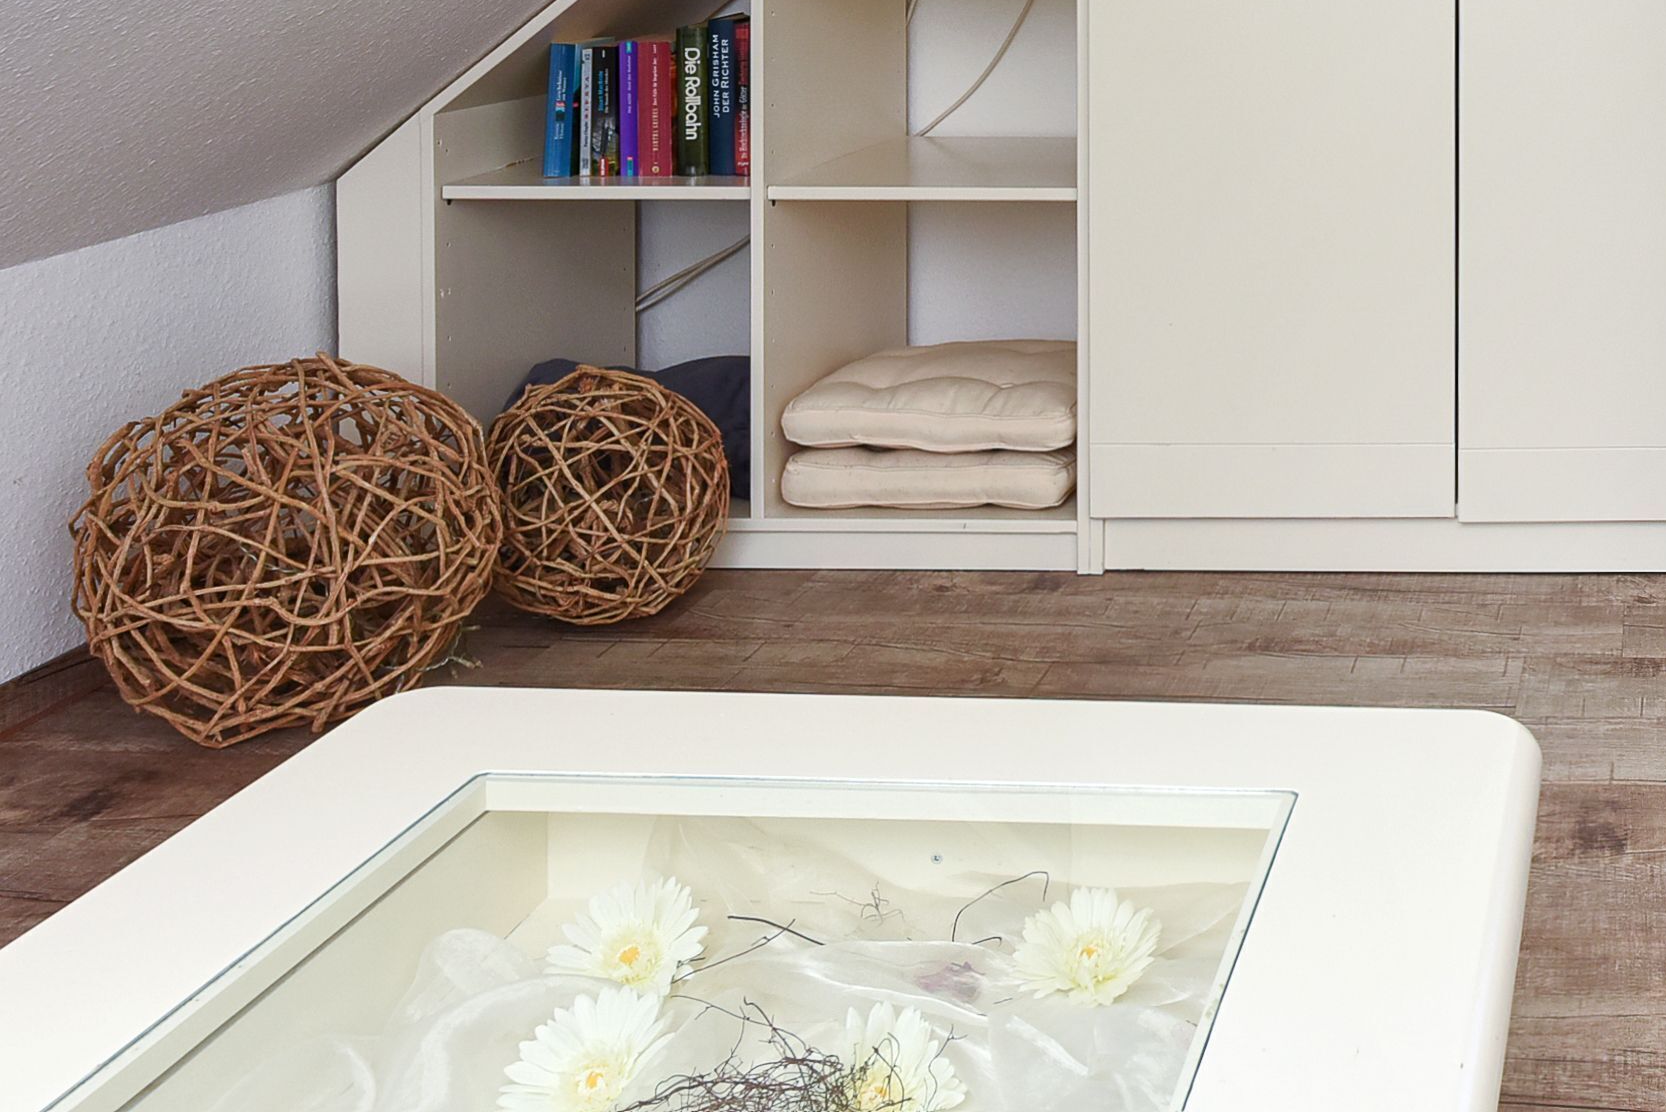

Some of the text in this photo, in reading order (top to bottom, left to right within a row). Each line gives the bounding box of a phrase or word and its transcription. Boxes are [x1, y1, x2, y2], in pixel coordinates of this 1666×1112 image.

[685, 48, 700, 140] Die Rollbahn
[711, 34, 720, 118] JOHN GRISHAM
[721, 38, 730, 113] DER RICHTER
